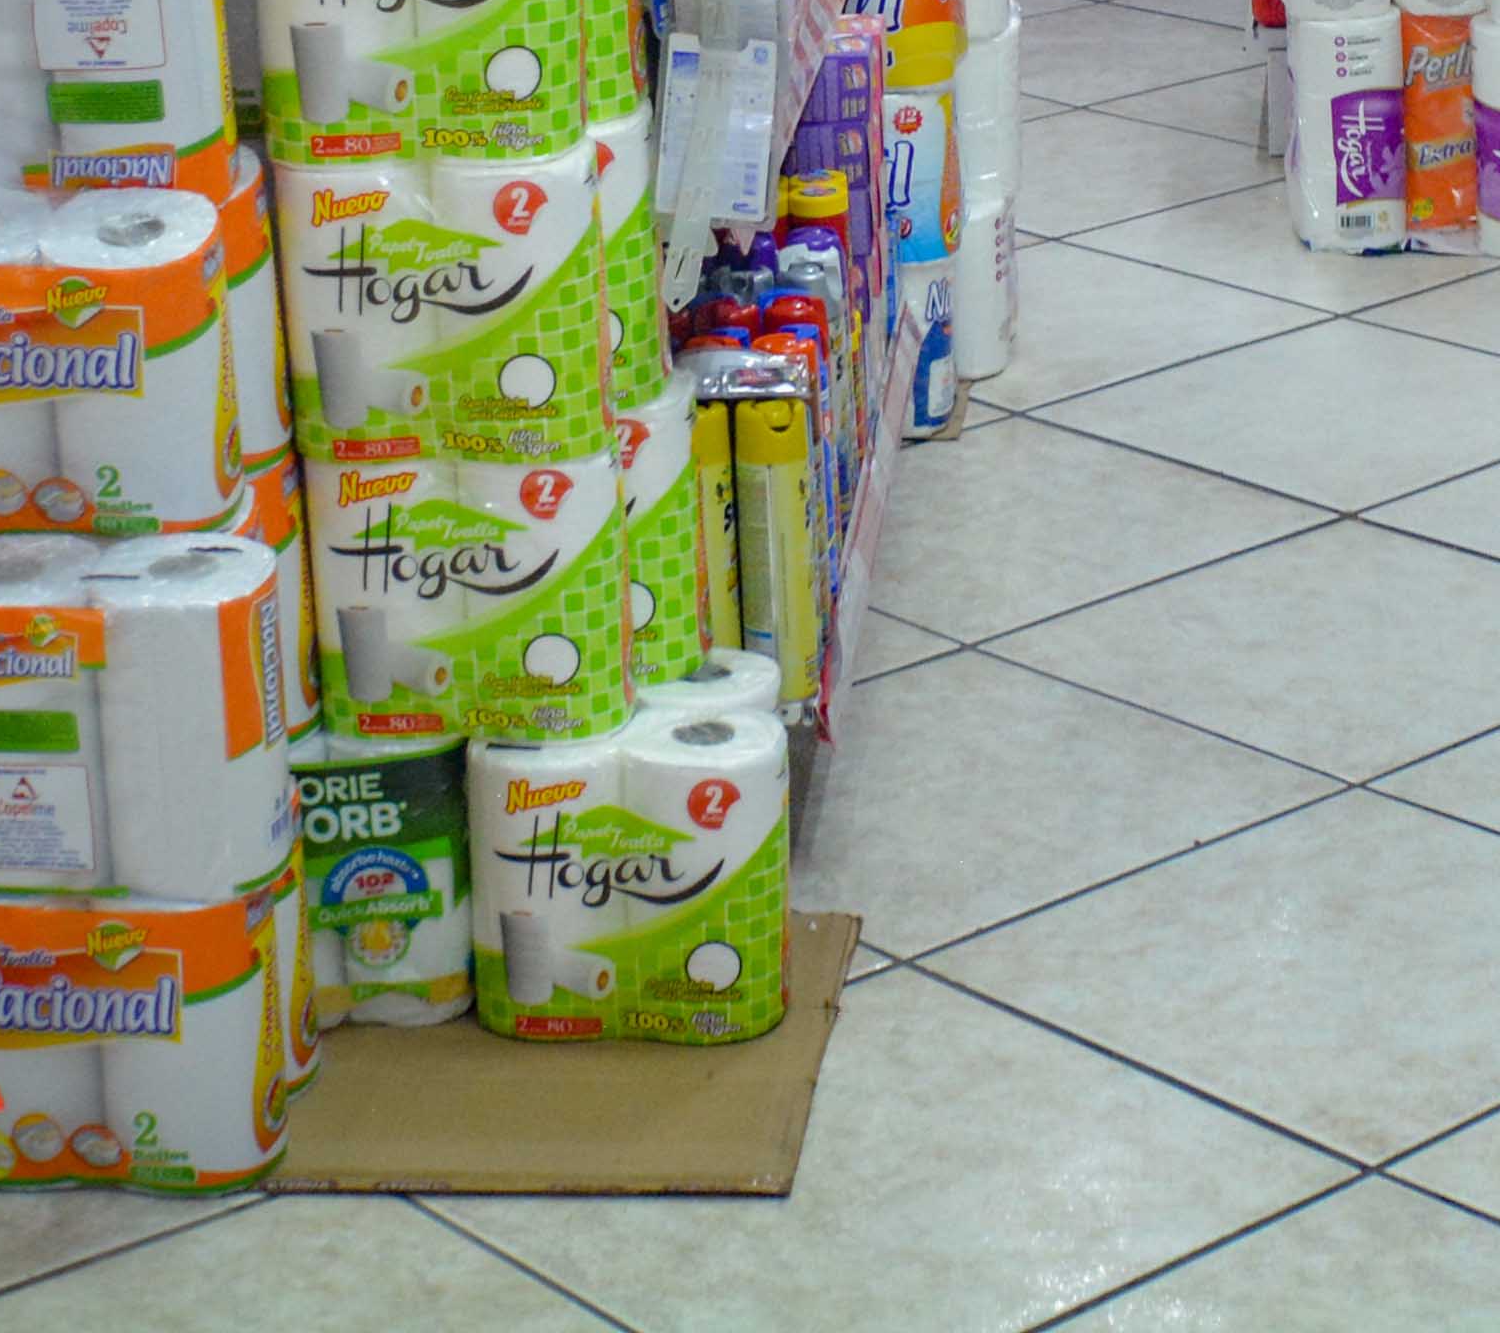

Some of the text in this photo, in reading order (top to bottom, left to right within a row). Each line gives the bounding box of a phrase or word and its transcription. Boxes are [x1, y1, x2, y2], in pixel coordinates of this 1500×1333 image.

[344, 135, 371, 152] 80
[423, 128, 489, 149] 100%
[1337, 100, 1387, 198] Hogar
[51, 154, 173, 188] Nacional
[311, 188, 390, 228] Nuevo
[510, 187, 530, 217] 2
[303, 222, 534, 324] Hogar
[46, 285, 109, 314] Nuevo
[442, 431, 504, 454] 100%
[96, 465, 122, 498] 2
[338, 470, 418, 508] Nuevo
[537, 474, 557, 504] 2
[327, 502, 560, 600] Hogar
[259, 602, 286, 746] Nacional
[299, 771, 384, 807] ORIE
[505, 778, 587, 814] Nuevo
[704, 785, 723, 814] 2
[494, 810, 725, 908] Hogar
[133, 1111, 158, 1146] 2
